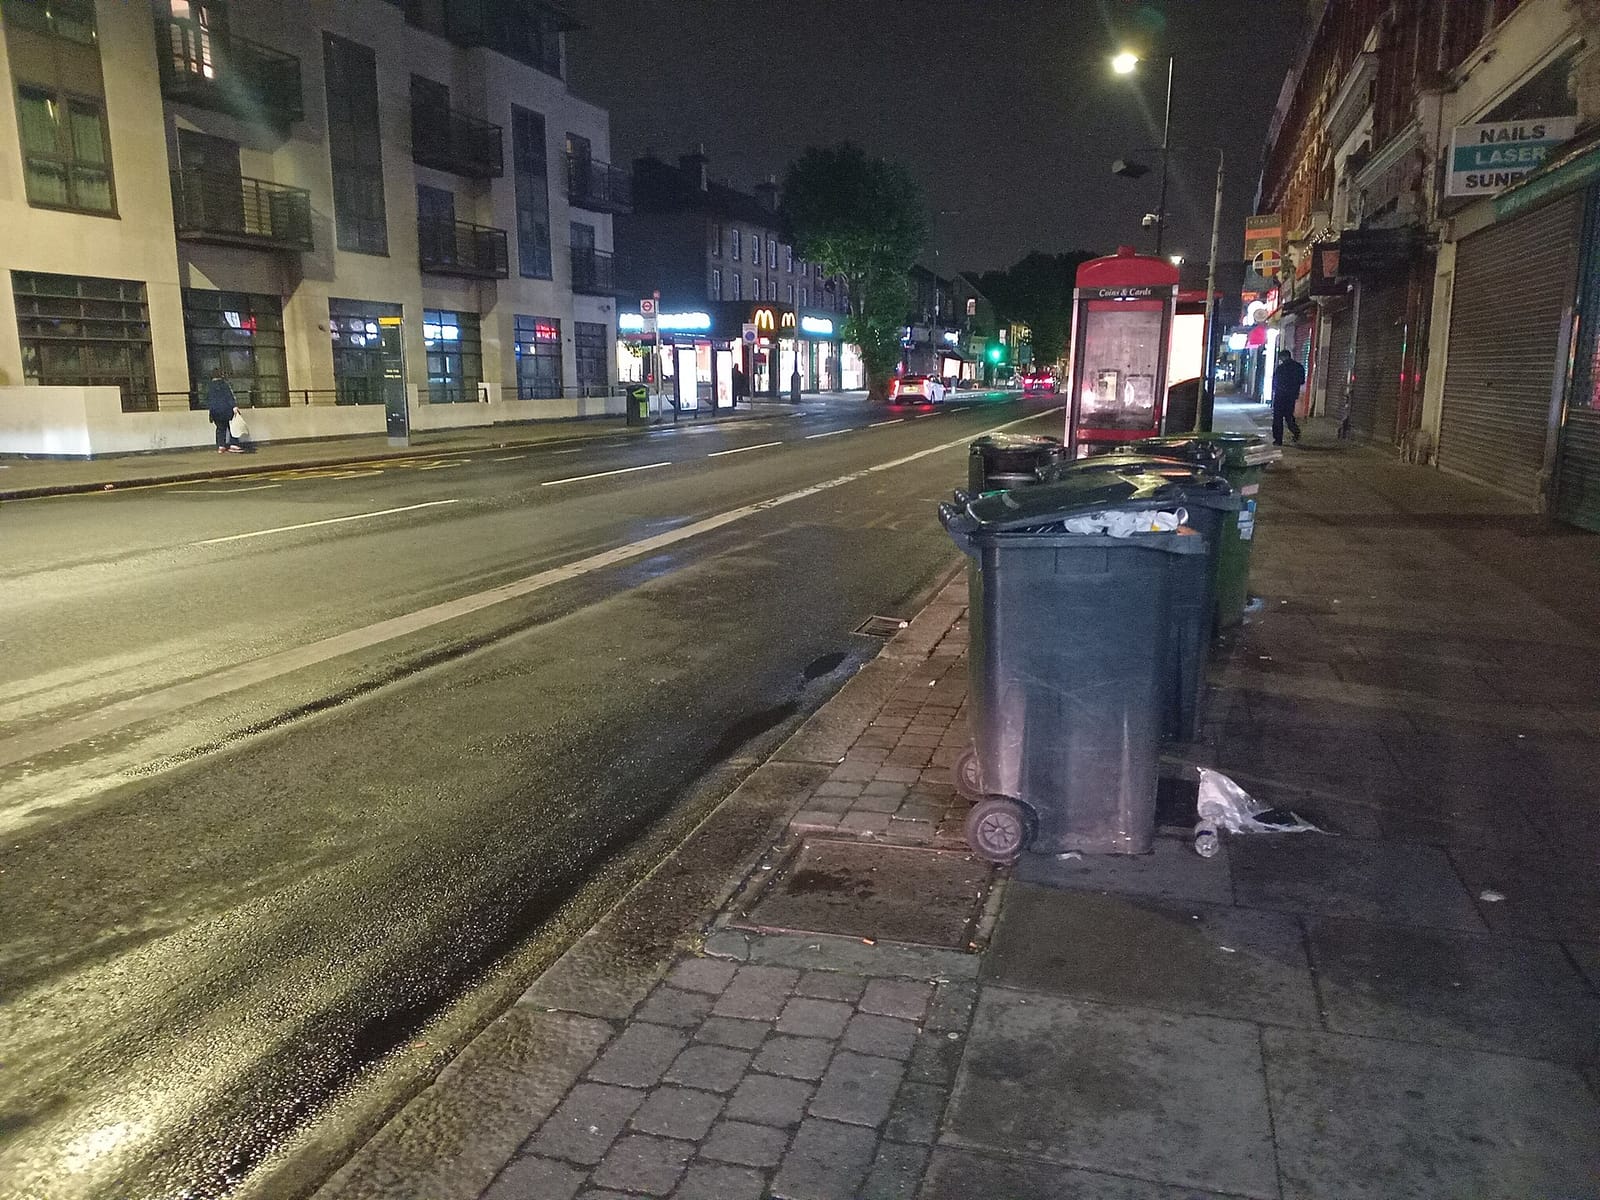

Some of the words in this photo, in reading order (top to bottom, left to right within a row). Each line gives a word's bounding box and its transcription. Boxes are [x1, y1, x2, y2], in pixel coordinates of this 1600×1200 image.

[1480, 125, 1545, 143] NAILS
[1475, 147, 1546, 165] LASER
[1099, 288, 1120, 297] Coins
[1120, 288, 1128, 296] &
[1129, 287, 1151, 296] Cards
